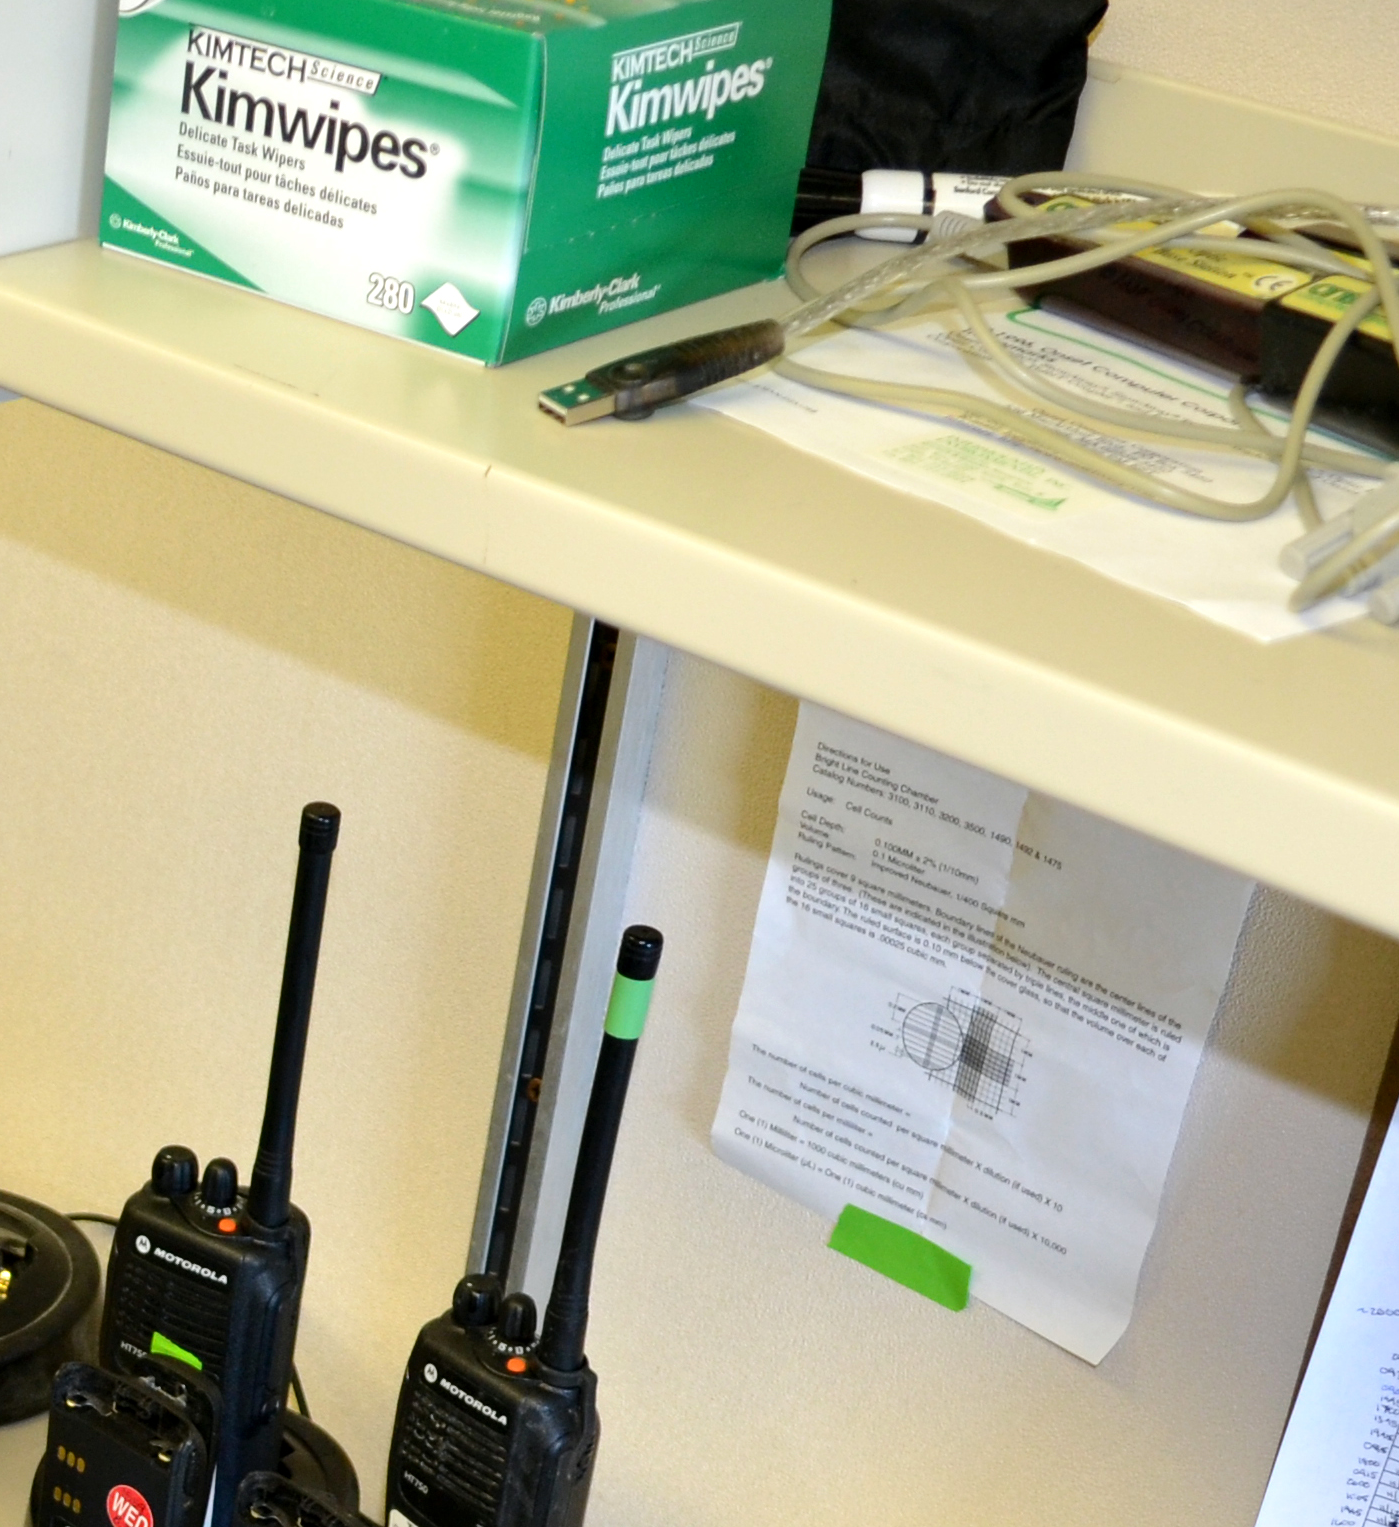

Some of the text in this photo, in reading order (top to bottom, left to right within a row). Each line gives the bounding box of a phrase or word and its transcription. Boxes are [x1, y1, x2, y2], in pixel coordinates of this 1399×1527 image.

[187, 28, 374, 90] KIMTECH Science
[611, 40, 693, 83] KIMTECH
[179, 120, 306, 172] Delicate Task Wipers
[602, 141, 640, 163] Delicate
[662, 126, 692, 148] Wipers
[176, 142, 378, 215] Essuie-tout pour tâches délicates
[624, 175, 645, 195] para
[673, 154, 714, 178] delicadas
[175, 166, 345, 229] Paños para tareas delicadas
[366, 272, 416, 315] 280
[548, 272, 641, 315] Kimberly-Clark
[598, 284, 660, 314] Professional
[1091, 364, 1181, 407] Computer
[814, 751, 939, 806] Bright Line Counting Chamber
[817, 741, 890, 776] Directions for Use
[800, 809, 817, 823] Cell
[812, 762, 845, 784] Catalog
[1042, 854, 1062, 870] 1475
[845, 800, 862, 815] Cell
[863, 807, 893, 828] Counts
[797, 830, 824, 849] Ruling
[870, 858, 909, 882] Improved
[980, 901, 1009, 921] Square
[887, 854, 925, 877] Microliter
[794, 850, 824, 871] Rulings
[857, 877, 885, 896] square
[934, 906, 974, 932] Boundary
[1016, 944, 1055, 970] Neubauer
[1055, 963, 1079, 982] ruling
[1109, 1003, 1150, 1028] millimeter
[153, 1247, 229, 1286] MOTOROLA
[438, 1377, 509, 1427] MOTOROLA
[404, 1470, 429, 1495] HT750
